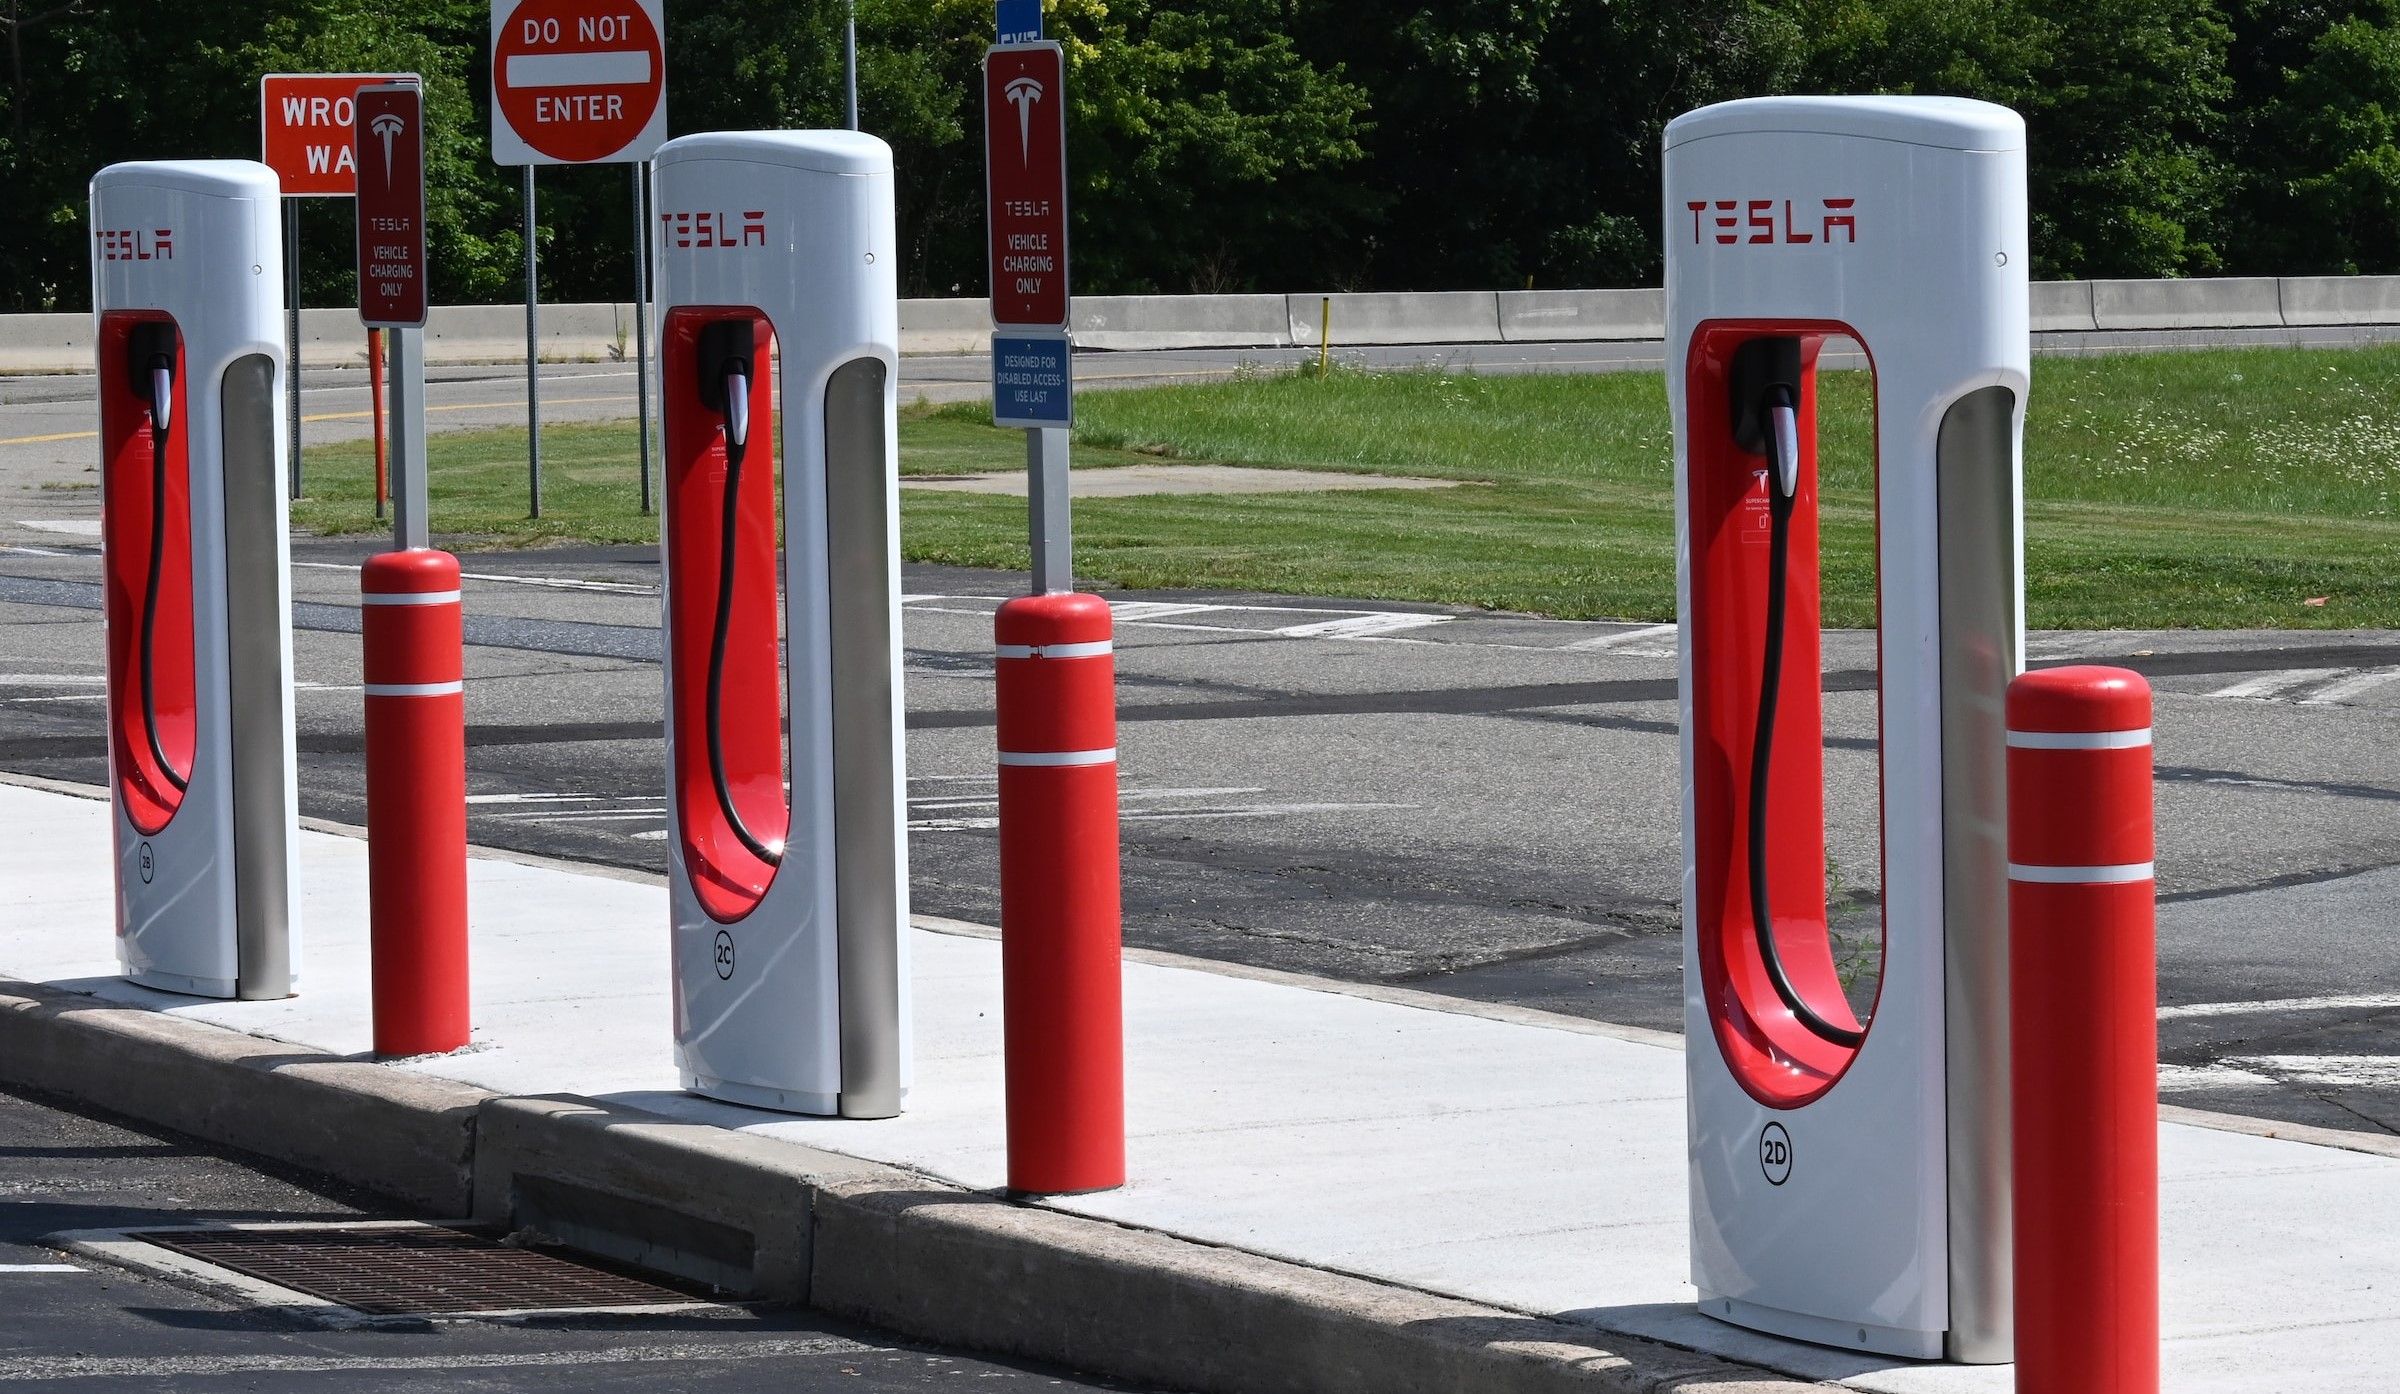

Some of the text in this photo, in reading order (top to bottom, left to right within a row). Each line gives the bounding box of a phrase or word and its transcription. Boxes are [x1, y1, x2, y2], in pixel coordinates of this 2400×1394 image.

[523, 15, 631, 45] DO NOT
[282, 96, 355, 127] WRO
[536, 95, 623, 123] ENTER
[306, 145, 356, 174] WA
[1005, 200, 1049, 216] TESLA
[371, 218, 410, 231] TESLA
[660, 211, 765, 248] TESLA
[1687, 198, 1856, 245] TESLA
[96, 229, 172, 260] TESLA
[1008, 234, 1048, 250] VEHICLE
[373, 246, 408, 260] VEHICLE
[369, 264, 413, 278] CHARGING
[1003, 256, 1053, 272] CHARGING
[380, 283, 403, 297] ONLY
[1016, 278, 1041, 294] ONLY
[1004, 355, 1056, 369] DESIGNED FOR
[998, 372, 1032, 385] DISABLED
[1014, 390, 1048, 403] USE LAST
[717, 944, 731, 965] 2C
[1764, 1140, 1787, 1165] 2D
